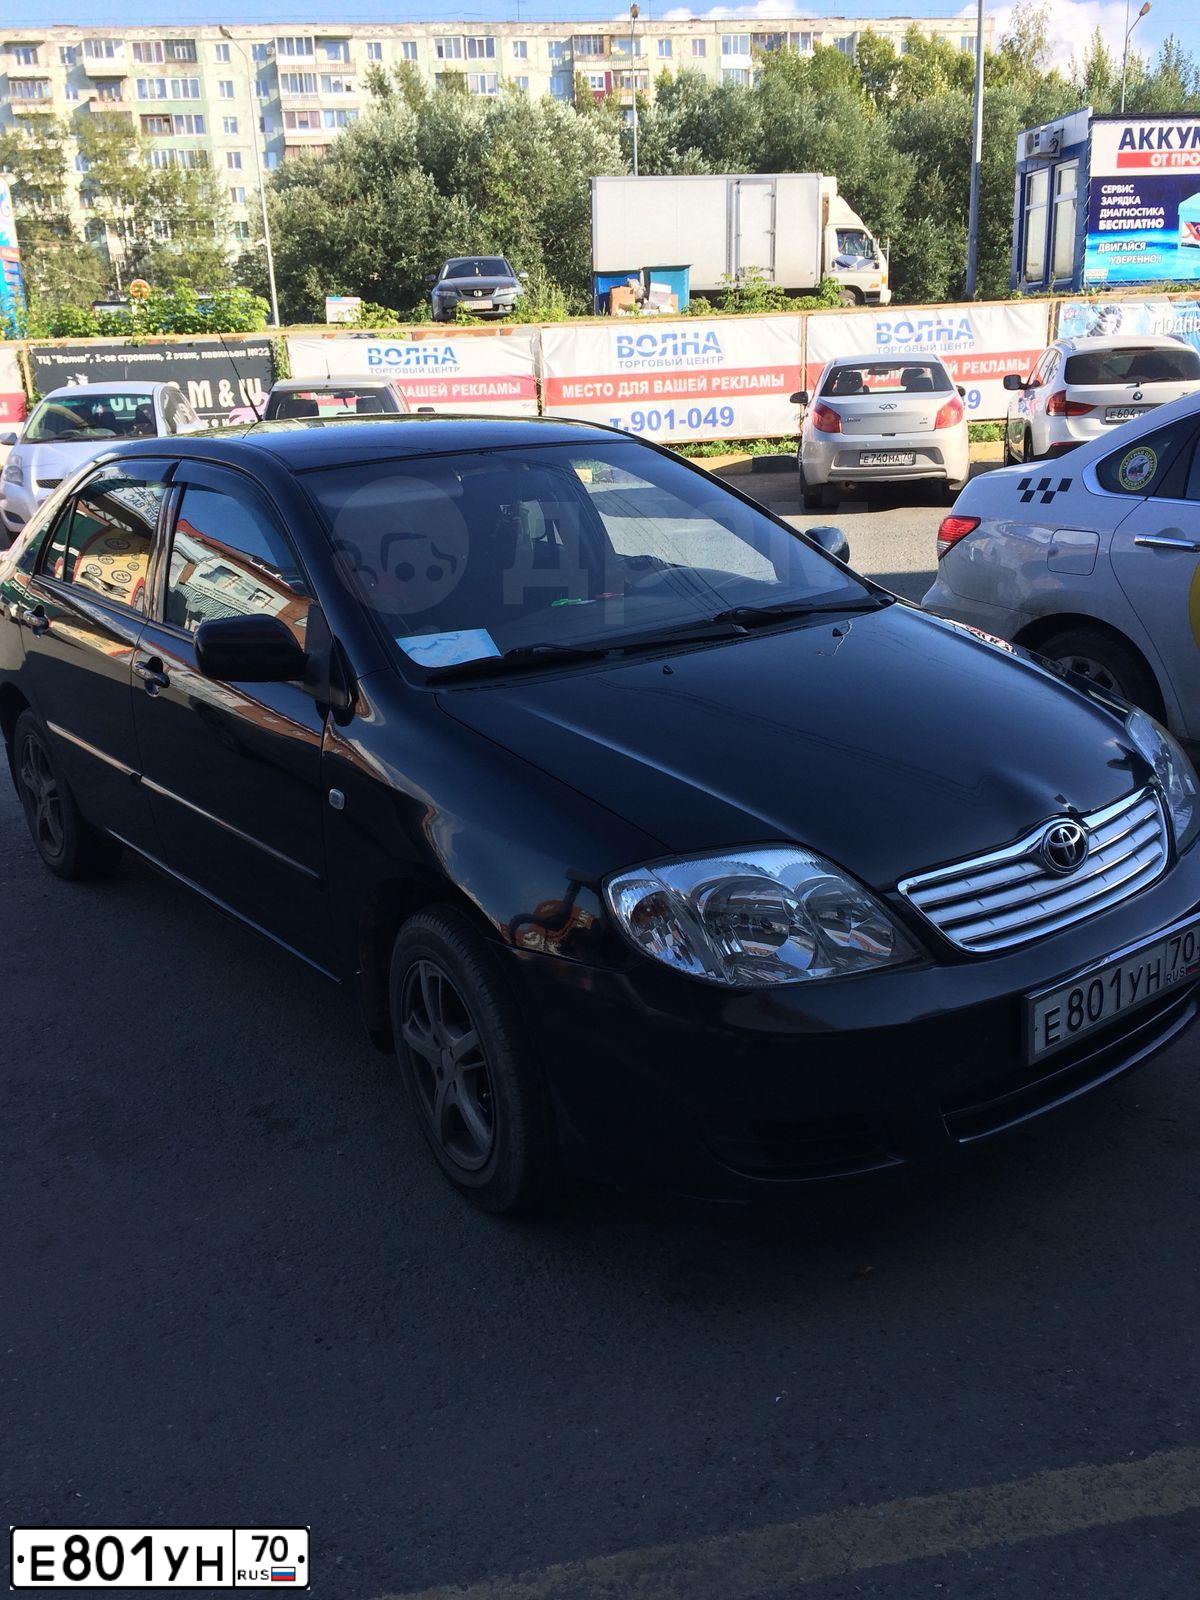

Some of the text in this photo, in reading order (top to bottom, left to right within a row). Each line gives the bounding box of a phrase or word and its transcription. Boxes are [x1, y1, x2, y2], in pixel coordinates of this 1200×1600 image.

[1150, 153, 1169, 167] ОТ
[1101, 184, 1135, 194] СЕРВИС
[1100, 195, 1142, 206] ЗАРЯДКА
[1099, 206, 1165, 219] ДИАГНОСТИКА
[1098, 218, 1165, 231] БЕСПЛАТНО
[1097, 240, 1147, 254] ДВИГАЙСЯ
[875, 318, 975, 345] ВОЛНА
[616, 331, 723, 359] ВОЛНА
[877, 341, 975, 354] ТОРГОВЫЙ ЦЕНТР
[36, 355, 51, 366] ТЦ
[165, 351, 173, 360] 2
[201, 350, 246, 359] павильон
[367, 346, 458, 366] ВОЛНА
[618, 356, 724, 369] ТОРГОВЫЙ ЦЕНТР
[369, 365, 460, 375] ТОРГОВЫЙ ЦЕНТР
[962, 357, 1031, 374] РЕКЛАМЫ
[452, 382, 521, 397] РЕКЛАМЫ
[562, 373, 784, 398] МЕСТО ДЛЯ ВАШЕЙ РЕКЛАМЫ
[187, 380, 214, 408] M
[218, 379, 236, 407] &
[1166, 966, 1186, 984] RUS
[1044, 931, 1195, 1048] Е801УН 70
